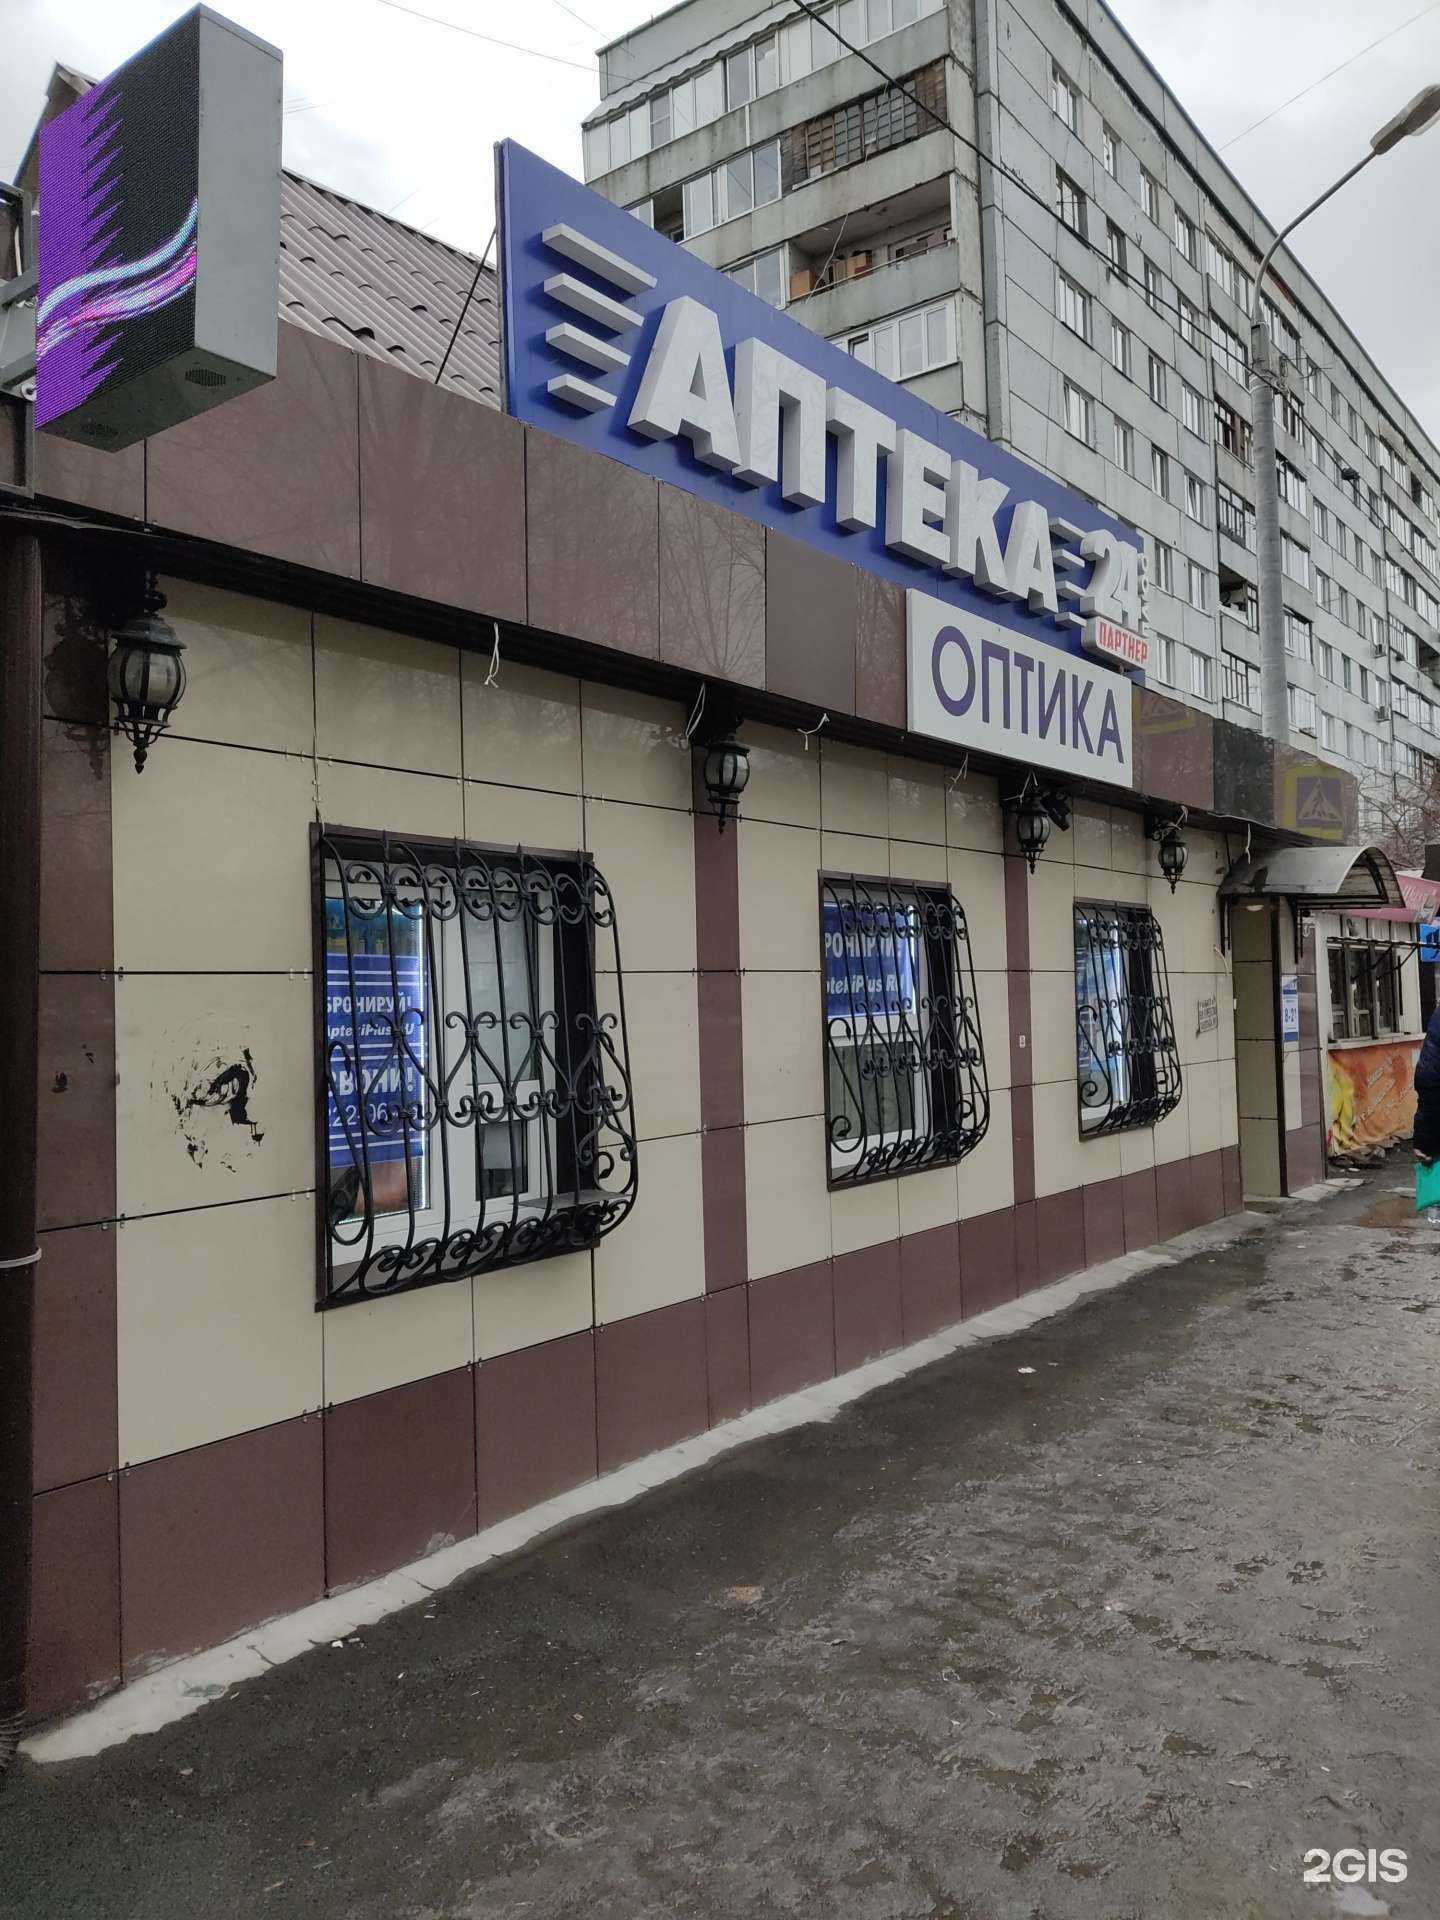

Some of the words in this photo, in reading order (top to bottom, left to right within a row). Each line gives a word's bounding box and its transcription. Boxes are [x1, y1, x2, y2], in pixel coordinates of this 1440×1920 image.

[628, 295, 1058, 616] АПТЕКА
[1080, 529, 1139, 633] 24
[1099, 622, 1149, 665] ПАРТНЕР
[932, 625, 1125, 764] ОПТИКА
[330, 1067, 415, 1096] ВОНИ!
